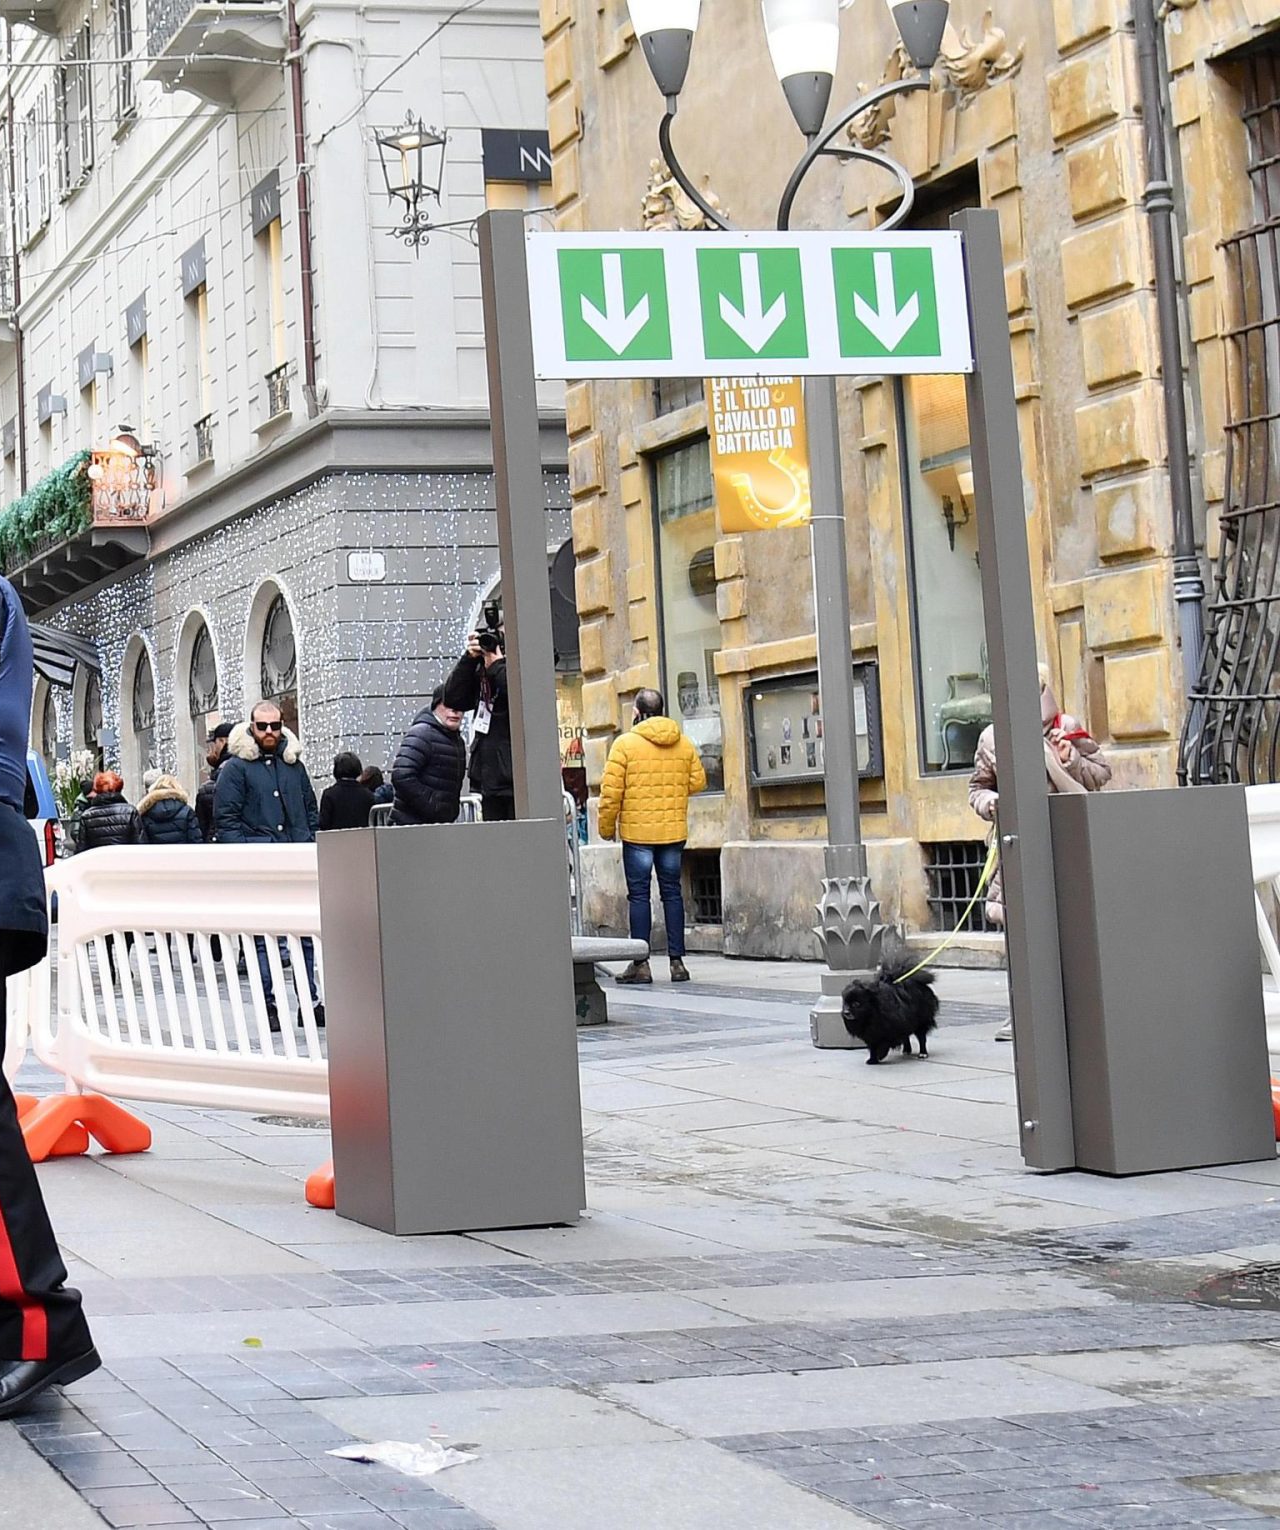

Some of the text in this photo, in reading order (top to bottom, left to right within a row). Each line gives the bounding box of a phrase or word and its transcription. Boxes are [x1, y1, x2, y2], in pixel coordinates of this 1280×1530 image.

[724, 390, 740, 411] IL
[741, 387, 770, 410] TUO
[714, 406, 796, 433] CAVALLO DI
[716, 428, 793, 455] BATTAGLIA
